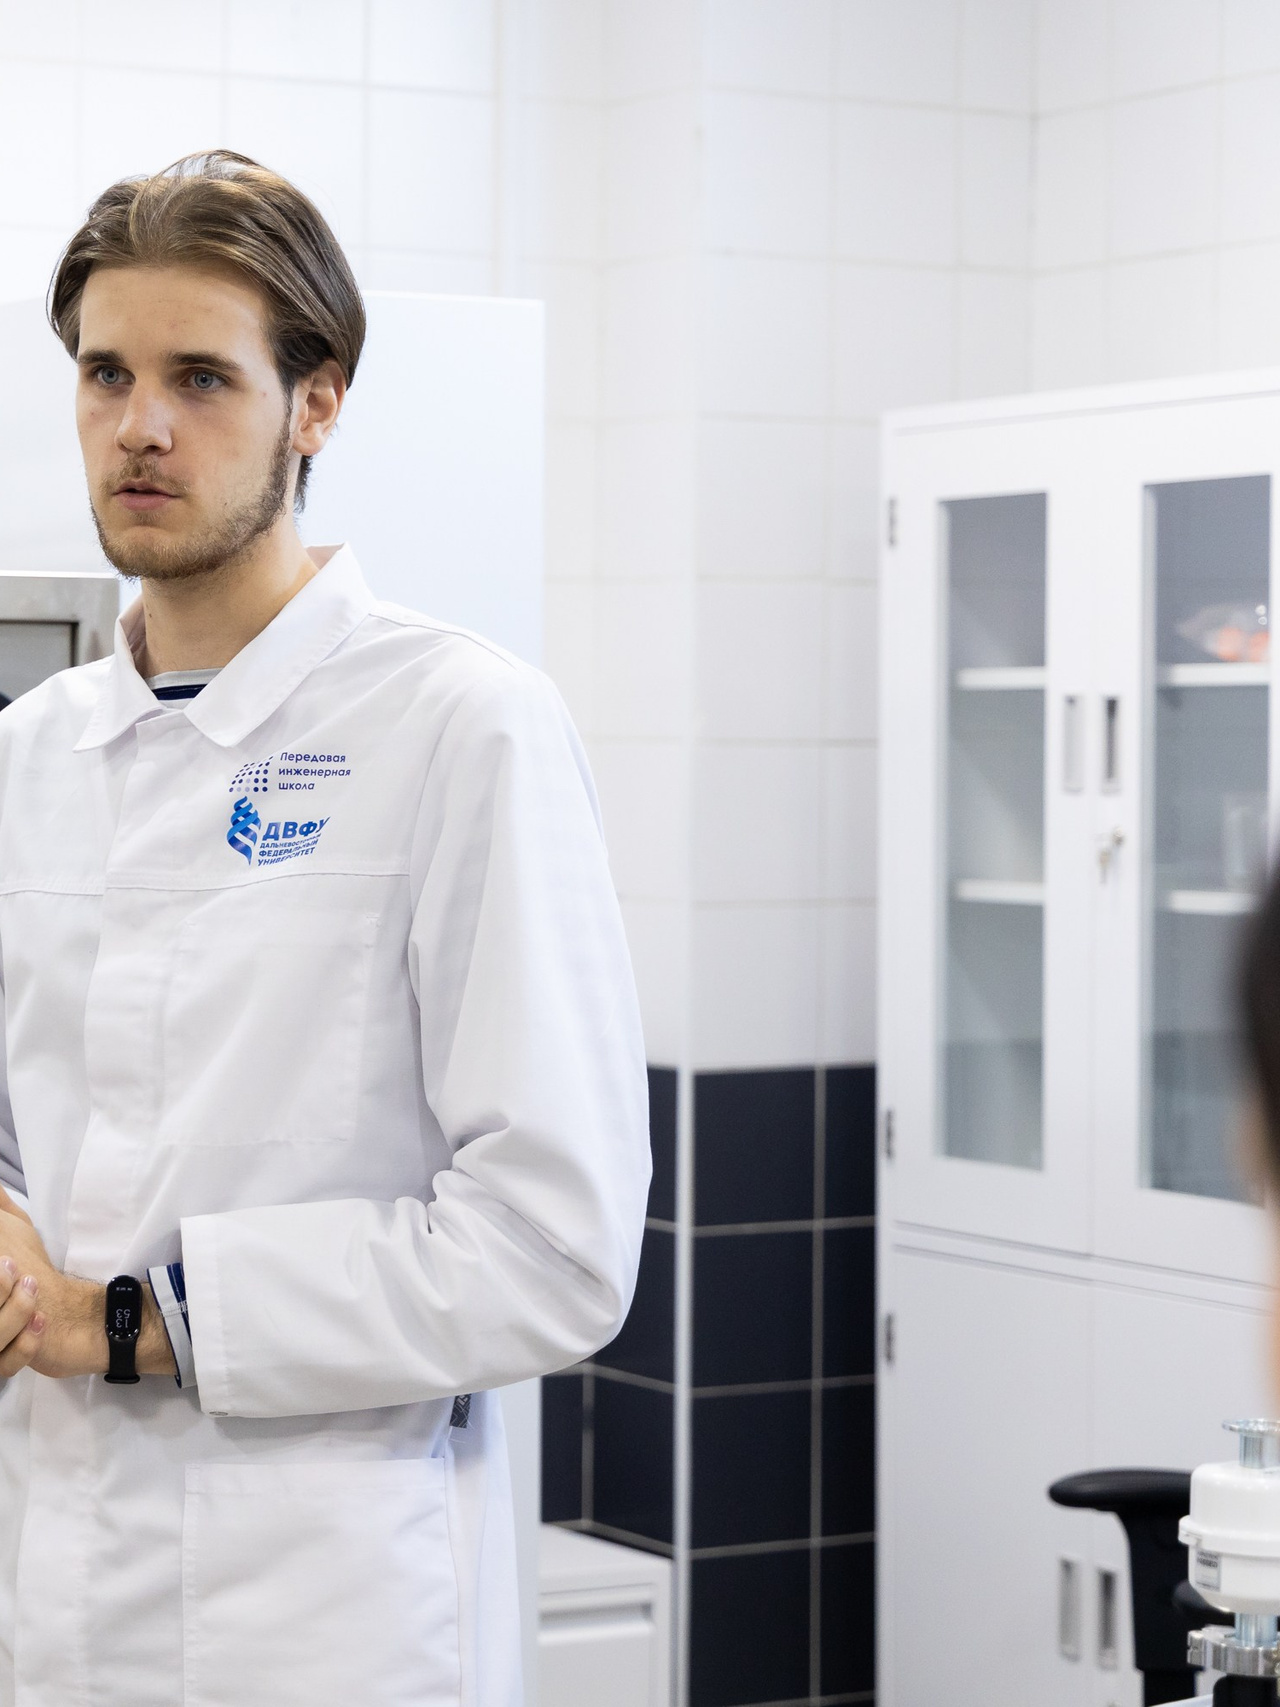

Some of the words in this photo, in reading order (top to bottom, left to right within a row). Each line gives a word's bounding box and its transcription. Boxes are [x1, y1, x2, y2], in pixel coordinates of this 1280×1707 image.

[280, 752, 346, 764] Передовая
[278, 767, 351, 778] инженерная
[278, 782, 315, 790] школа
[262, 816, 331, 841] ДВФУ
[260, 833, 322, 849] ДАЛЬНЕВОСТ
